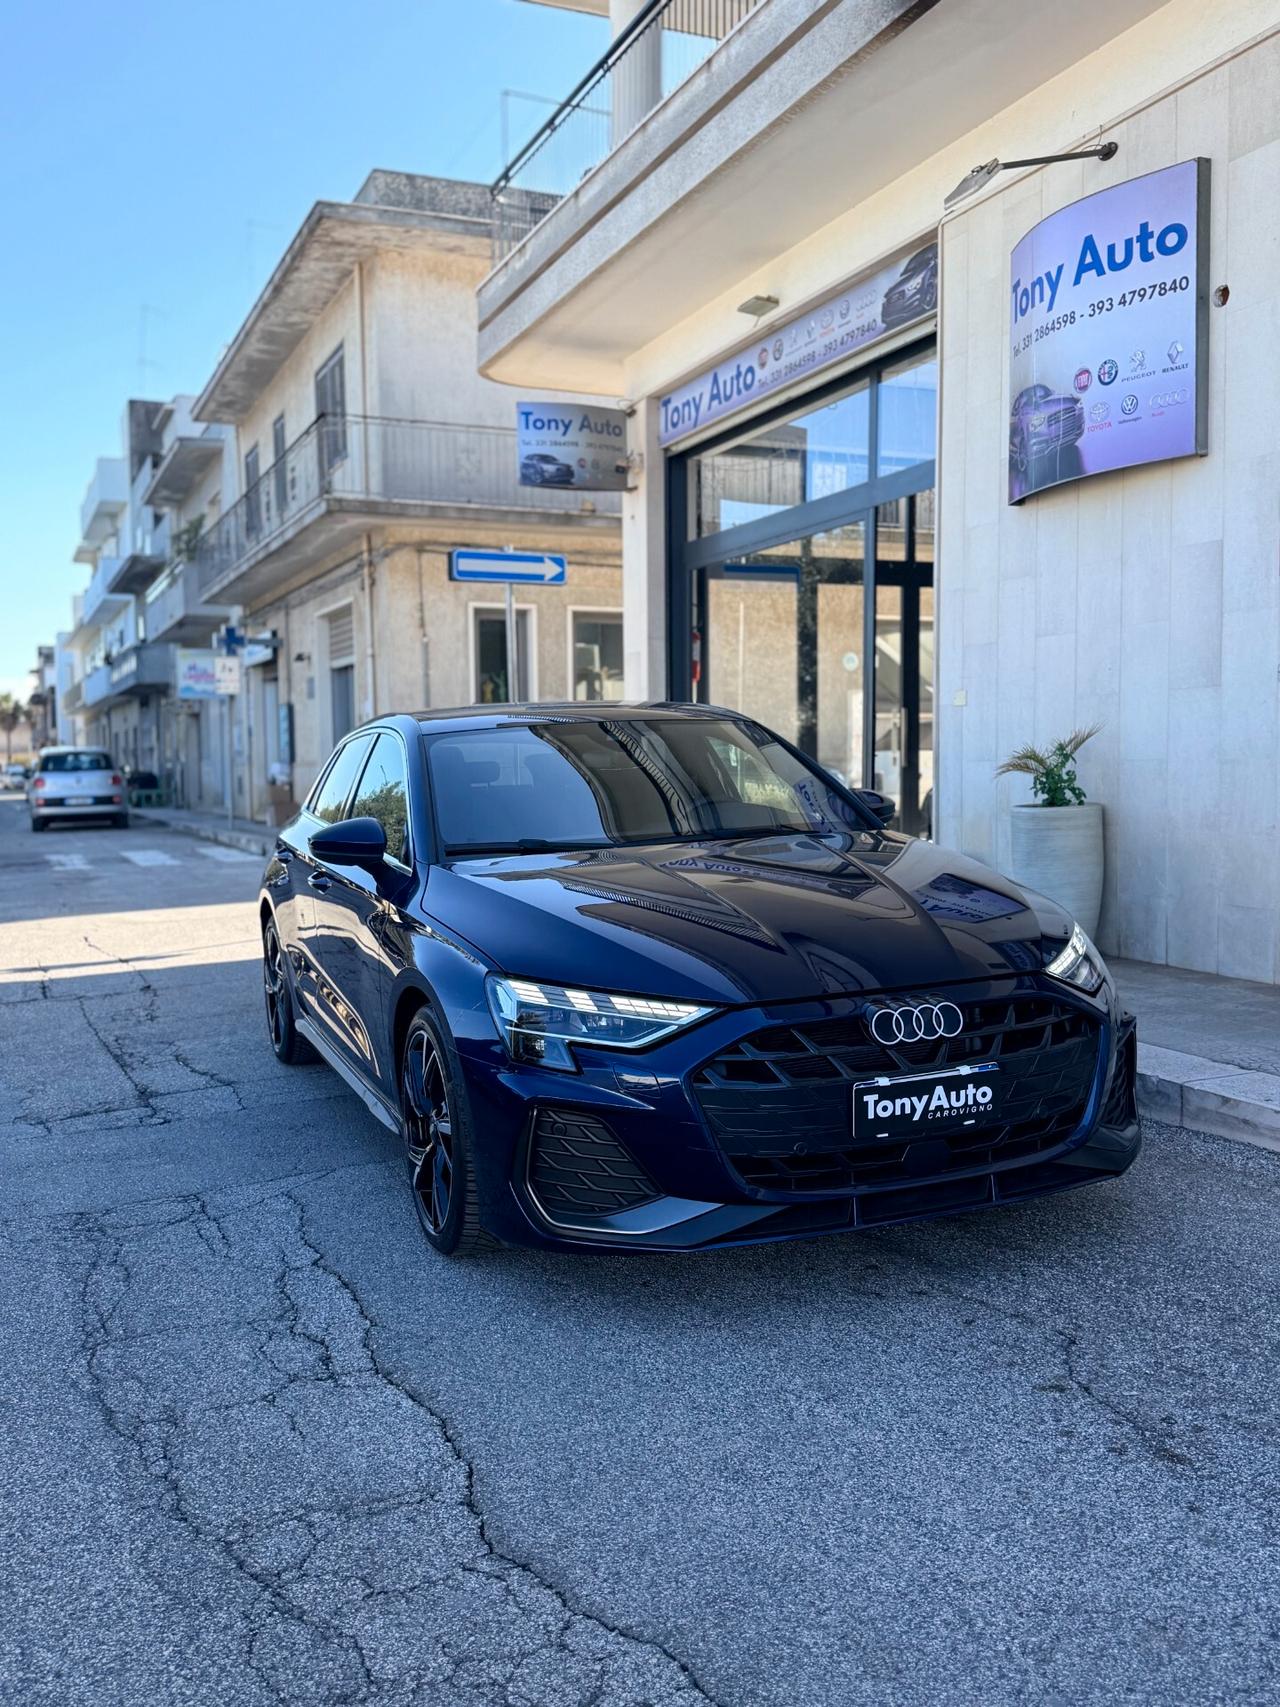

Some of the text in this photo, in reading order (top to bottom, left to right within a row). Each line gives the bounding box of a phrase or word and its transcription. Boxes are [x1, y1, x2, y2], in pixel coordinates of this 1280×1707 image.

[1012, 221, 1188, 325] Tony Auto
[1034, 310, 1077, 343] 2864598
[1088, 297, 1114, 318] 393
[1117, 275, 1190, 307] 4797840
[1121, 370, 1157, 382] PEUGEOT
[661, 363, 756, 433] Tony Auto
[521, 411, 622, 438] Tony Auto
[1087, 421, 1112, 433] TOYOTA
[863, 1083, 993, 1122] TonyAuto
[927, 1103, 993, 1120] CAROVIGNO
